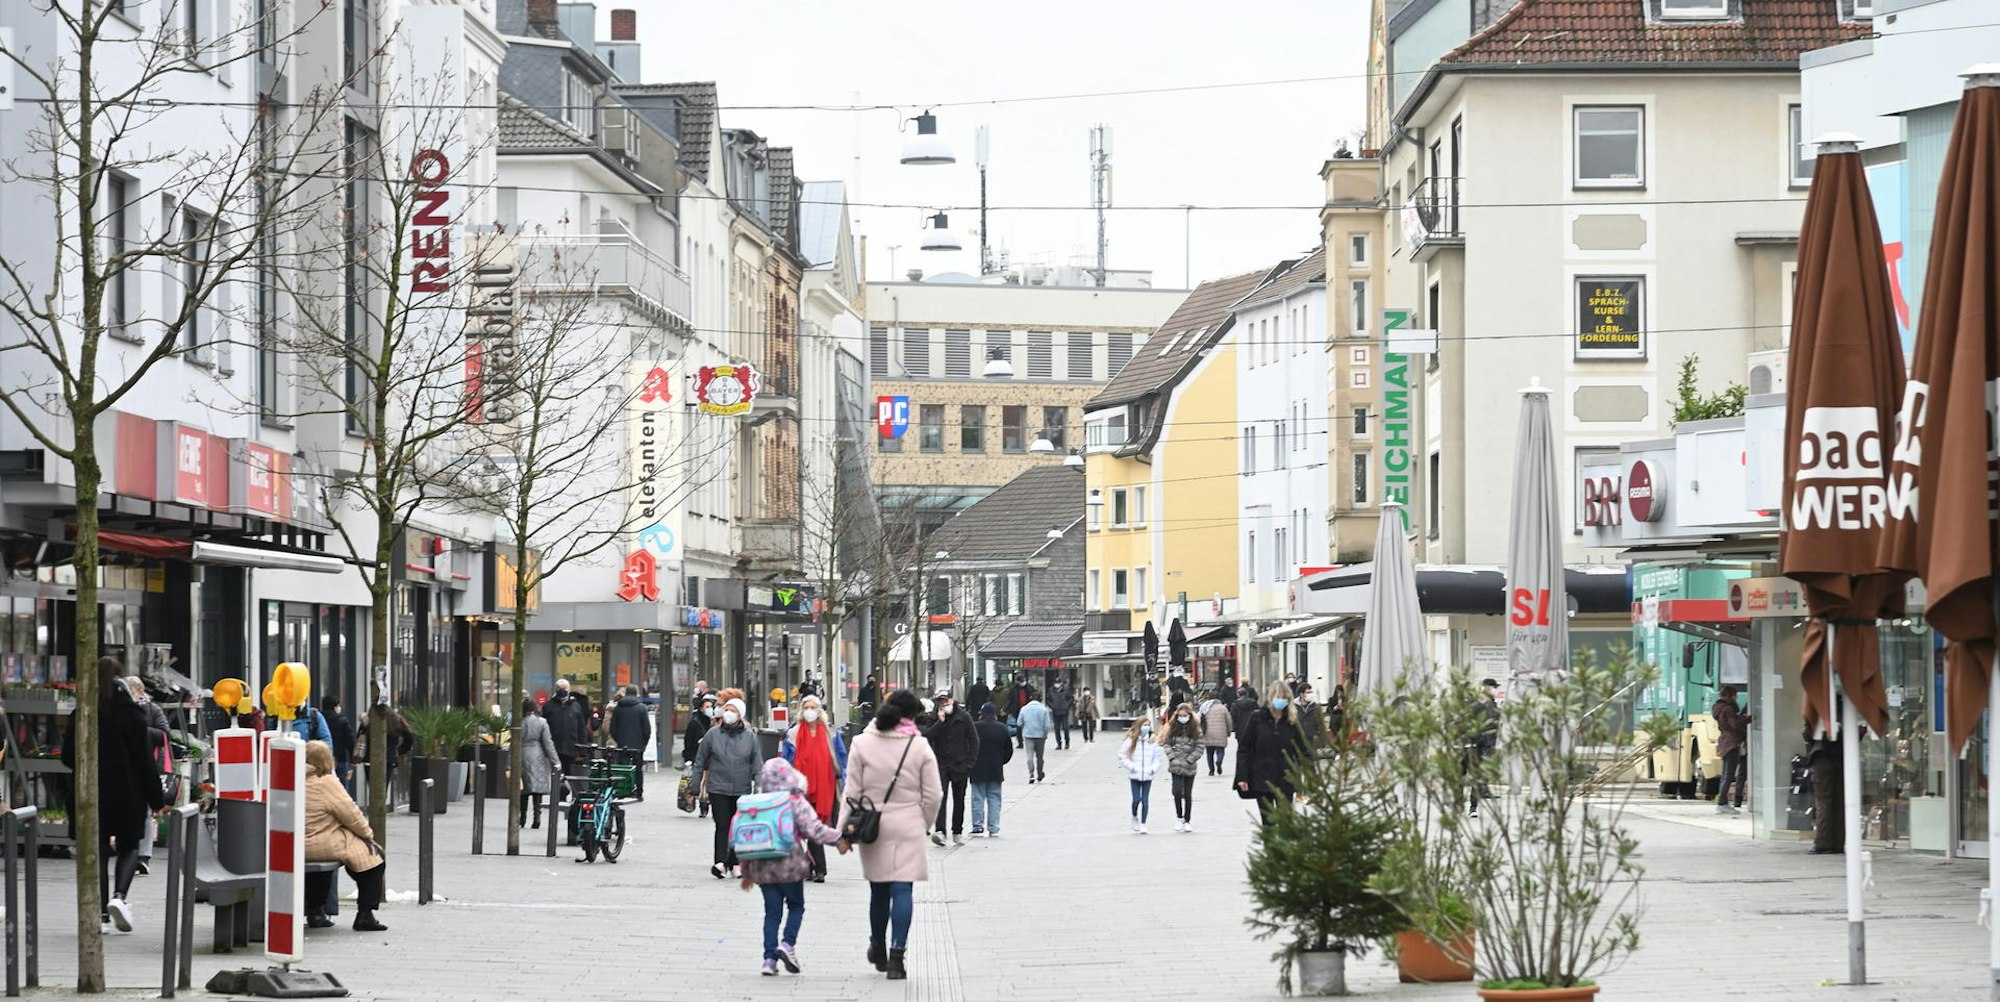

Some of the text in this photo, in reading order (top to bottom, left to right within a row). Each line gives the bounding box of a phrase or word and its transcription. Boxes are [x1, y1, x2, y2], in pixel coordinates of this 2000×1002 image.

[412, 149, 450, 292] RENO
[1596, 288, 1623, 297] E.B.Z.
[1588, 297, 1630, 306] SPRACH-
[1594, 306, 1625, 315] KURSE
[1605, 315, 1613, 324] &
[1595, 325, 1624, 333] LERN-
[639, 410, 655, 519] elefanten
